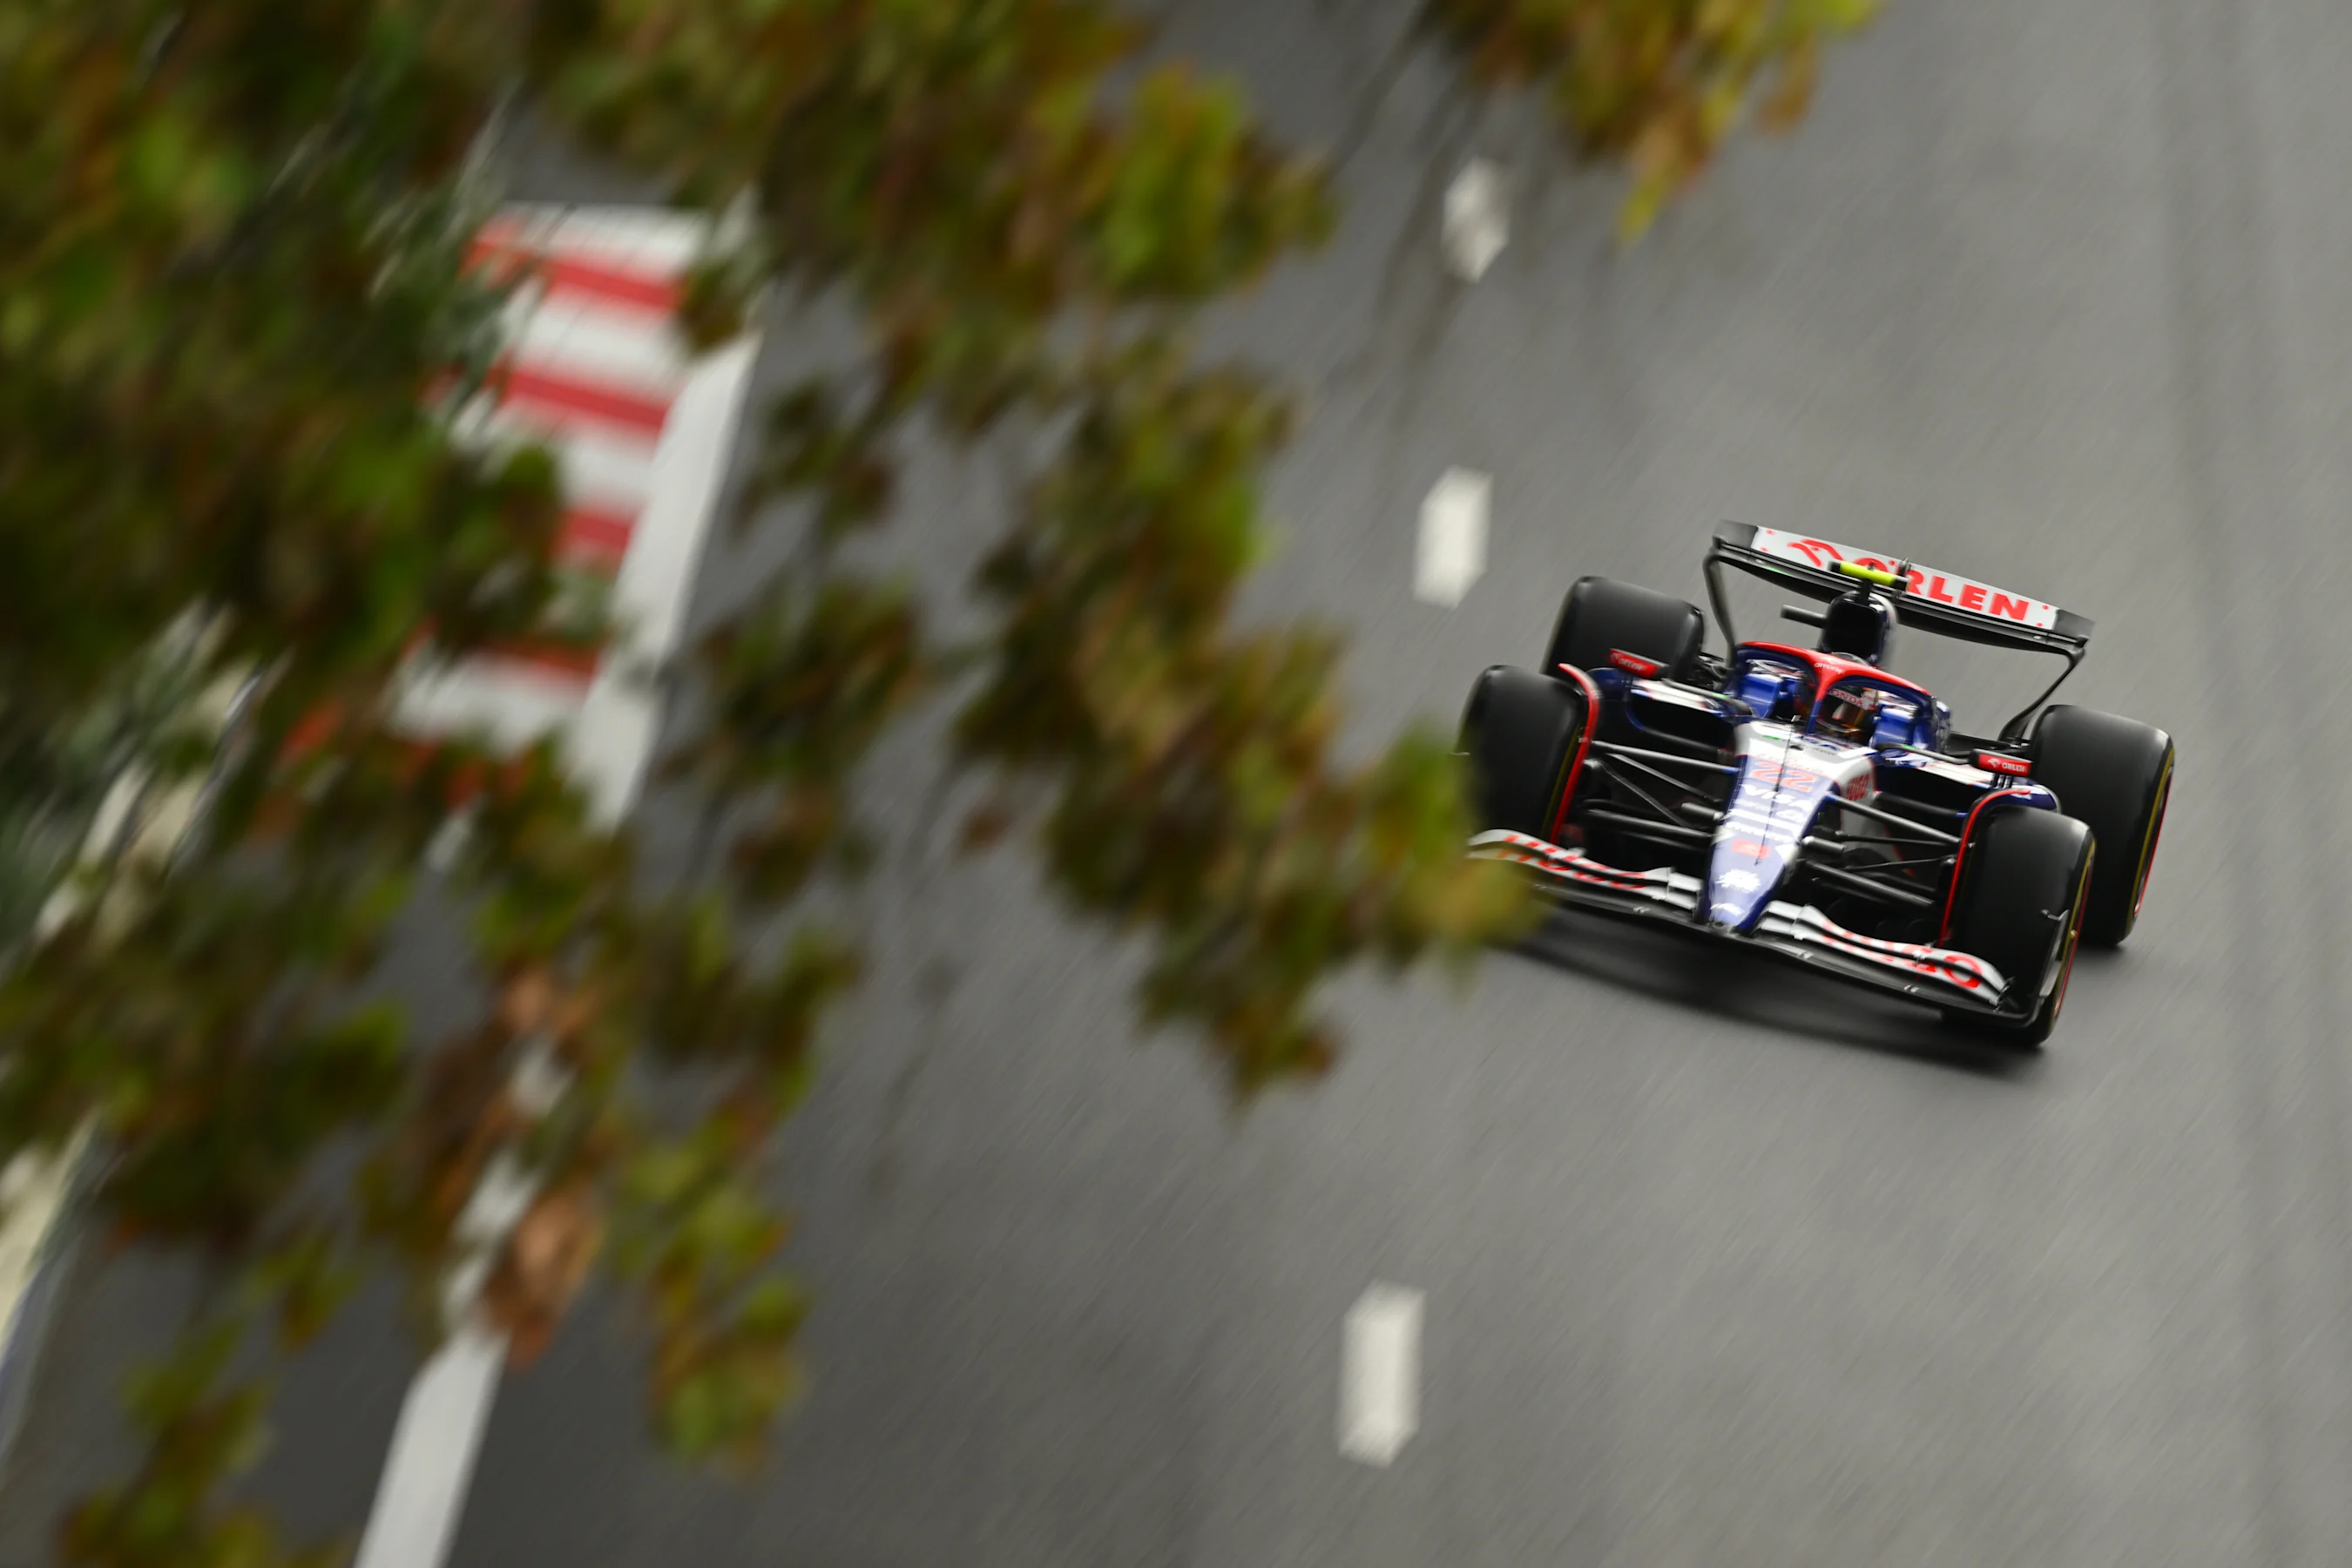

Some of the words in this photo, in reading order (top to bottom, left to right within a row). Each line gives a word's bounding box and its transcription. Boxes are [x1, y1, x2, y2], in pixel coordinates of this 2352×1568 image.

[1828, 688, 1863, 707] ONDA
[1750, 760, 1816, 794] 22
[2002, 762, 2025, 773] ORLEN
[1740, 783, 1814, 813] VISA
